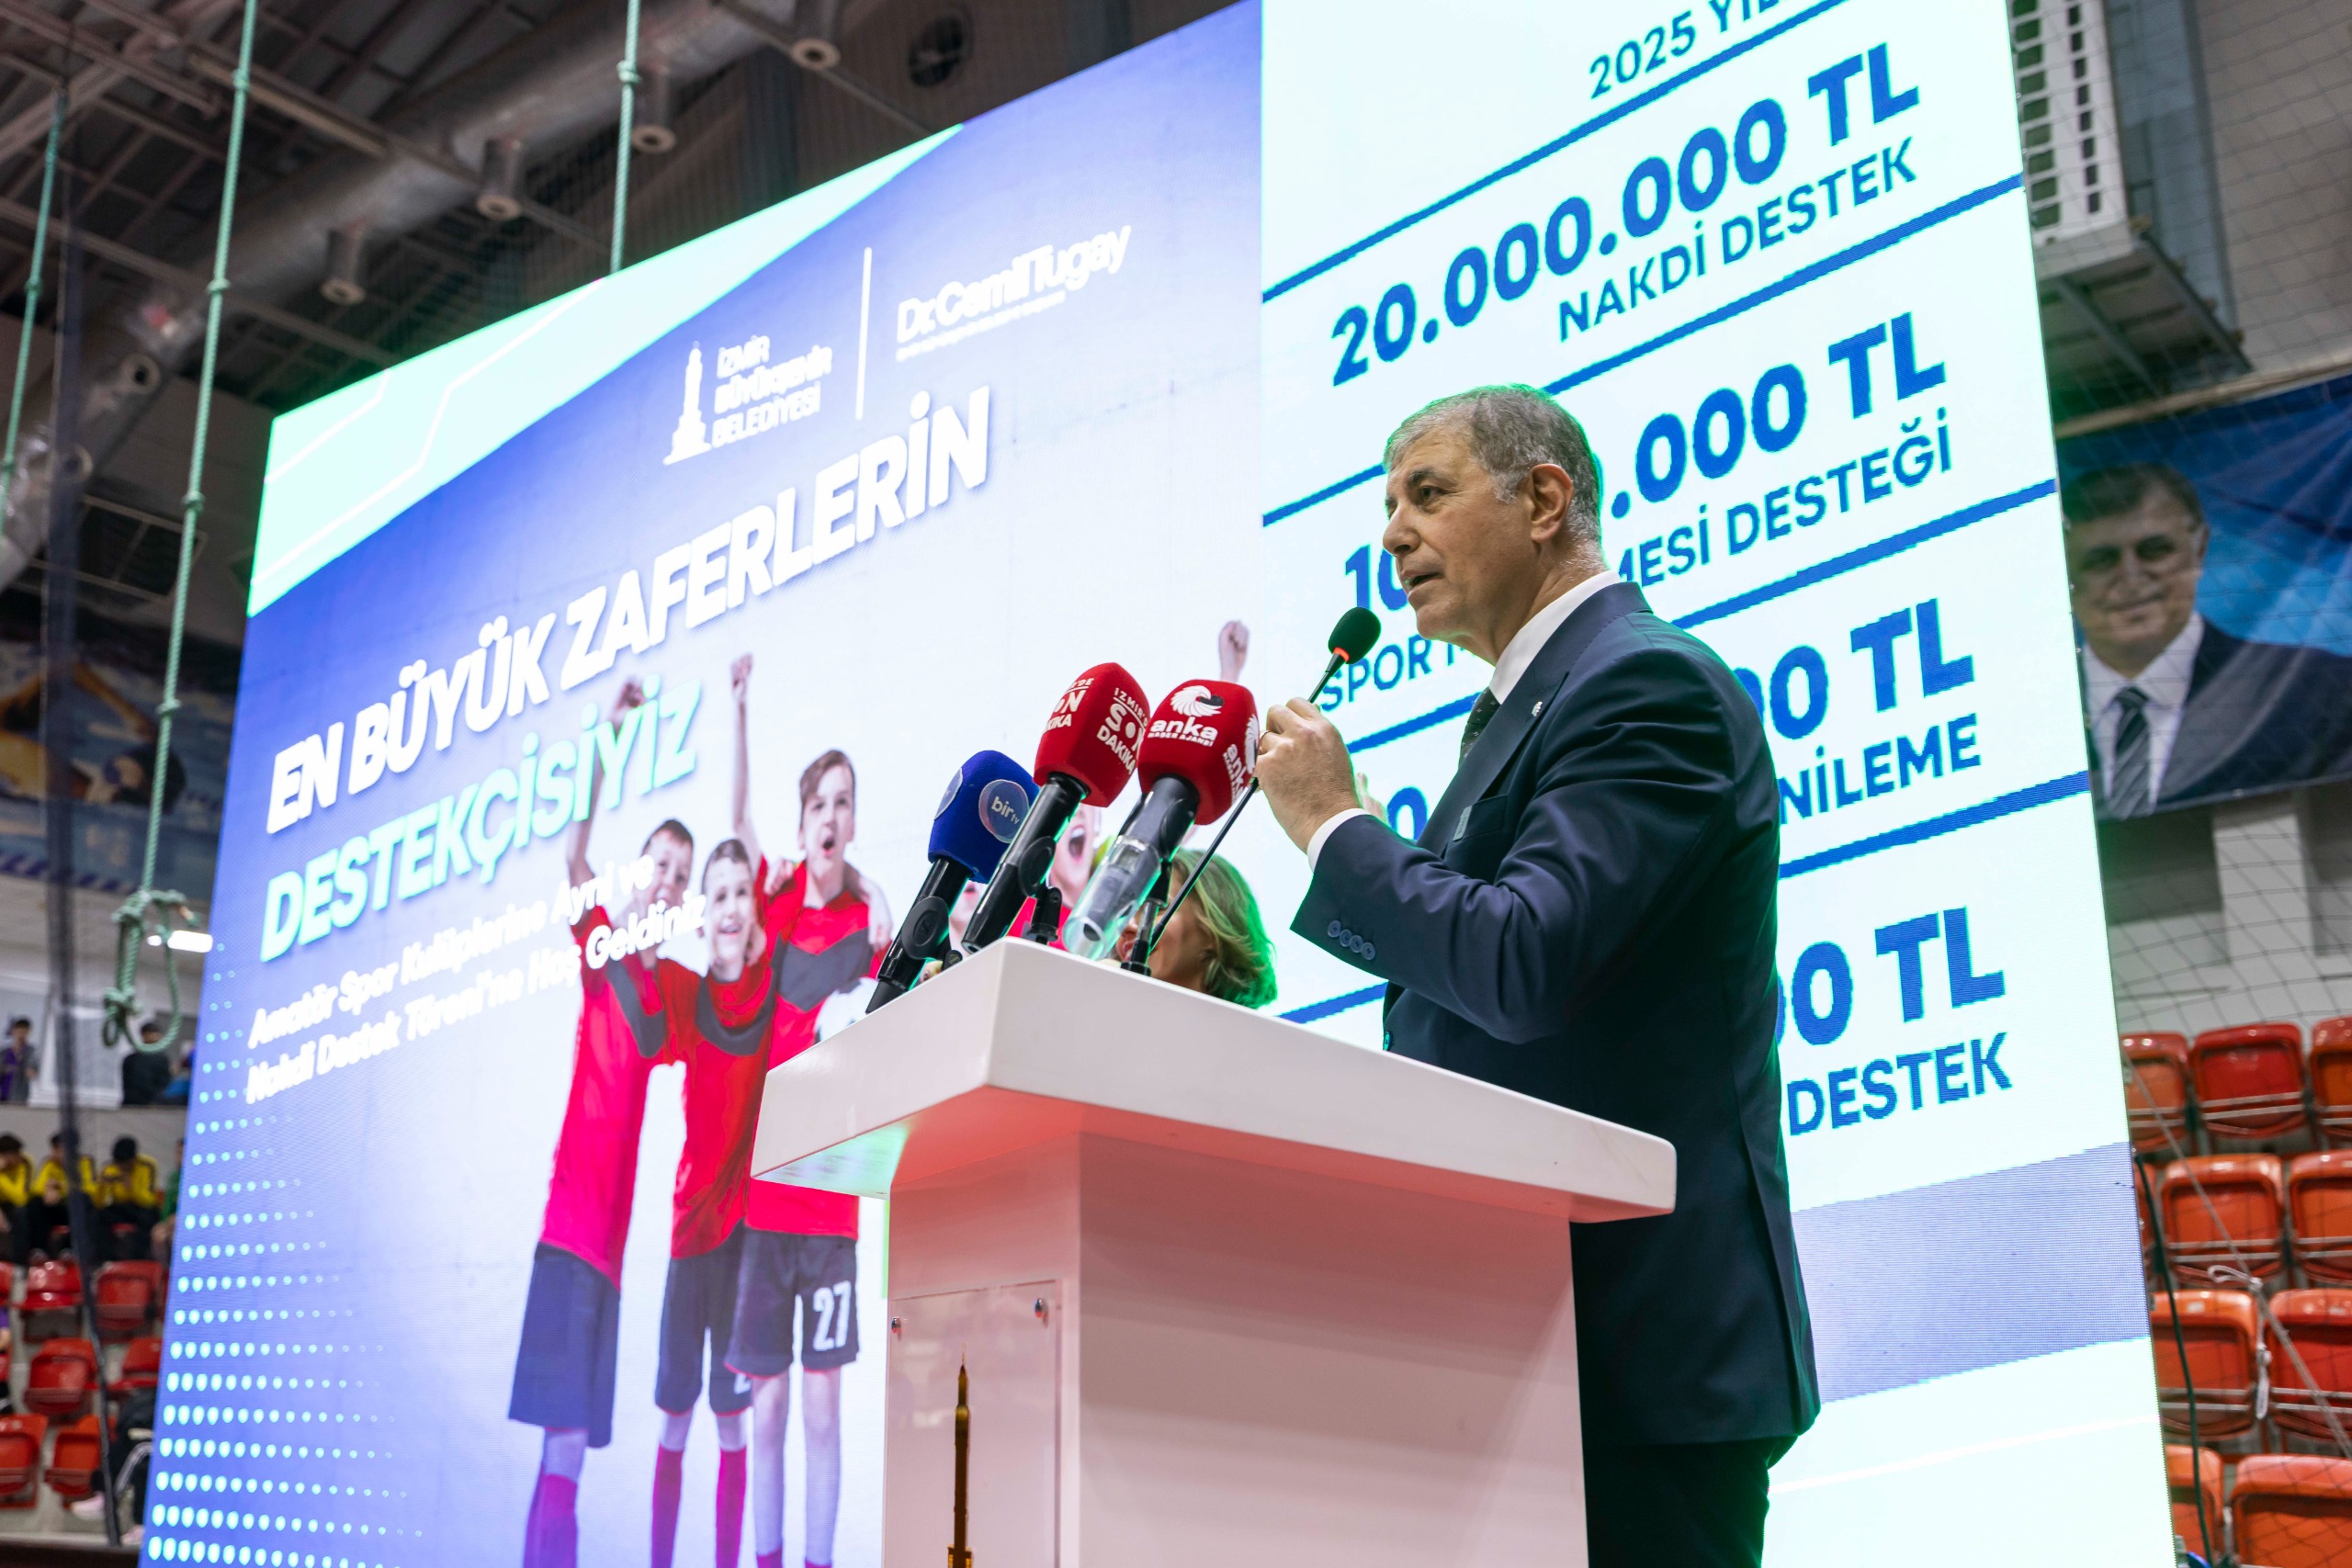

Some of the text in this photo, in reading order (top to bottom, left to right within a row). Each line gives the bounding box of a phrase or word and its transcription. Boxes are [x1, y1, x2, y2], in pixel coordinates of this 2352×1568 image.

[1589, 11, 1696, 98] 2025
[1331, 43, 1920, 386] 20.000.000 TL
[1559, 137, 1917, 341] NAKDİ DESTEK
[1828, 312, 1945, 419] TL
[1727, 407, 1952, 555] DESTEĞİ
[266, 387, 991, 833] EN BÜYÜK ZAFERLERİN
[1850, 598, 1974, 713] TL
[1097, 726, 1136, 775] DAKİKA
[1149, 716, 1218, 742] anka
[1777, 712, 1981, 825] NİLEME
[260, 674, 703, 962] DESTEKÇİSİYİZ
[991, 796, 1014, 818] bir
[1011, 815, 1020, 825] tv
[338, 962, 399, 1015] Spor
[618, 854, 654, 896] ve
[585, 889, 706, 970] Geldiniz
[1874, 906, 2006, 1022] TL
[1787, 1032, 2013, 1135] DESTEK
[813, 1280, 852, 1351] 27
